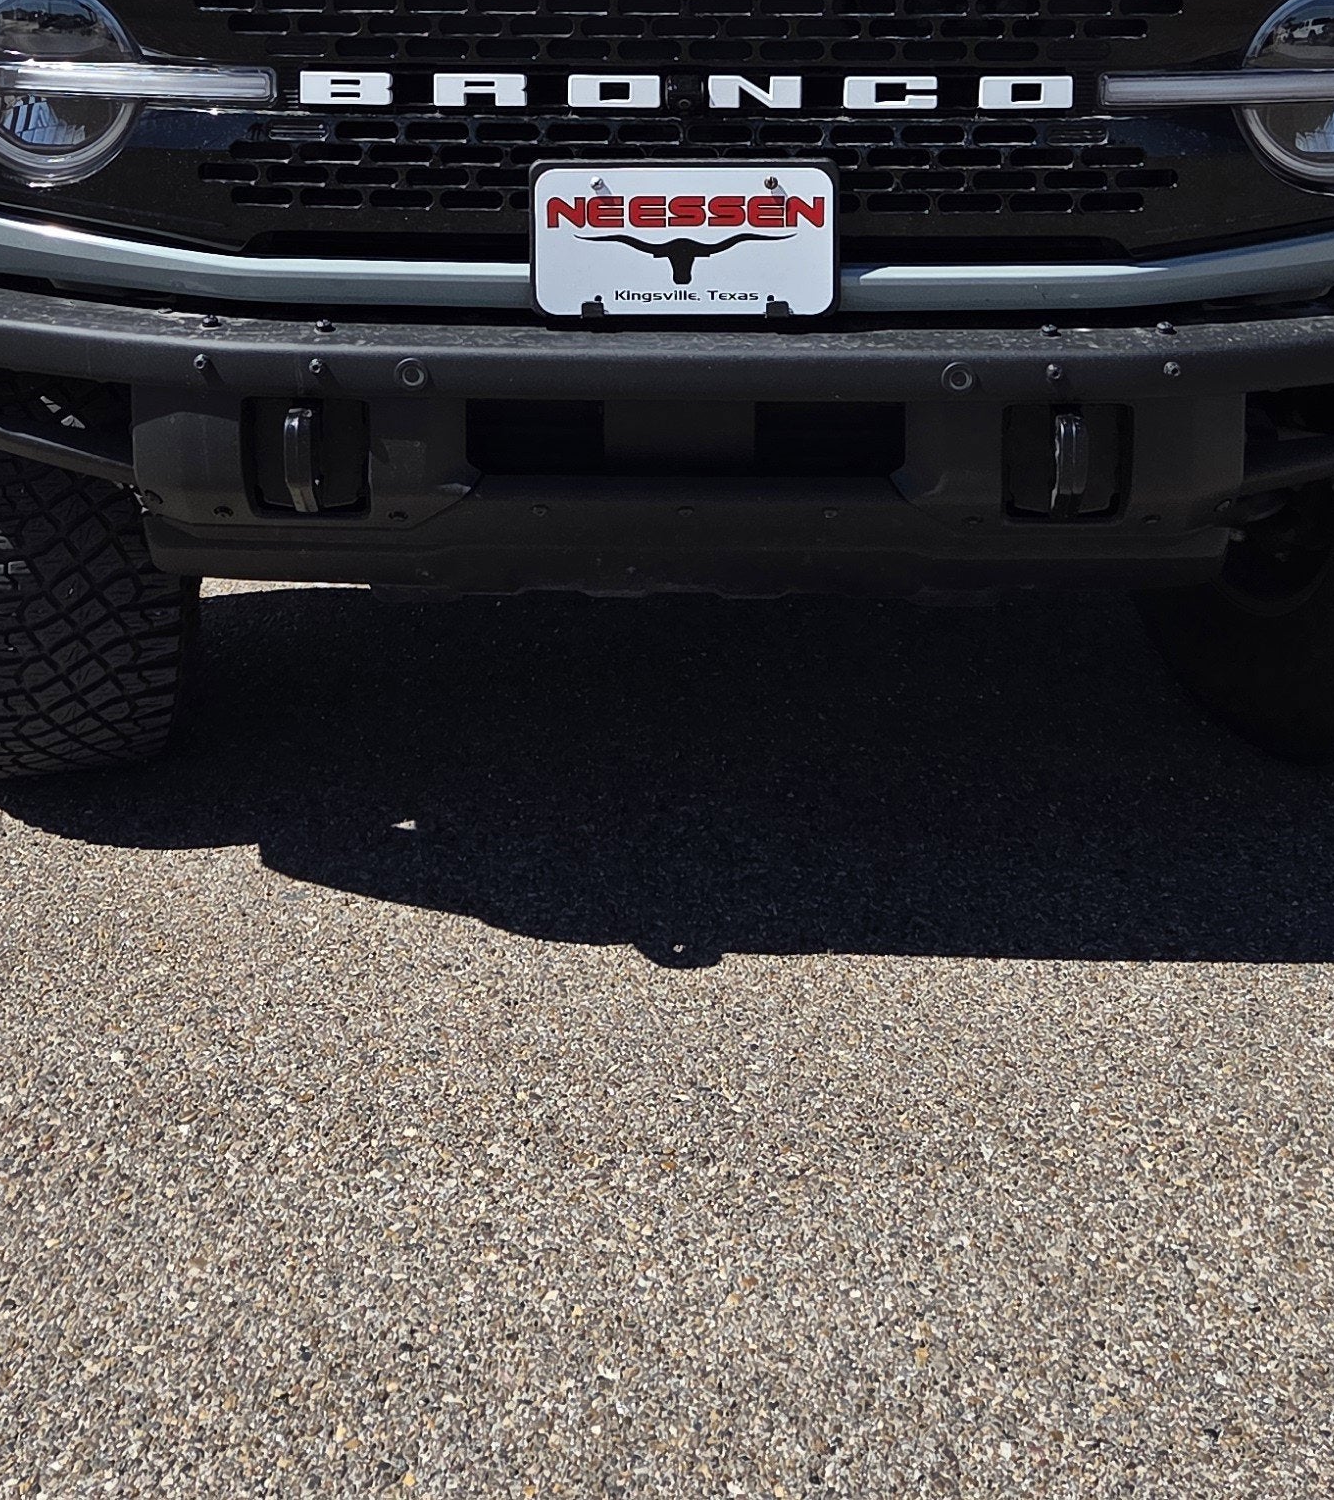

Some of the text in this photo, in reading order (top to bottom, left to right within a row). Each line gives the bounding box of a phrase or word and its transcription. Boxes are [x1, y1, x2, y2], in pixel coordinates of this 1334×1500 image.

[299, 71, 1073, 110] BRONCO
[546, 195, 825, 228] NEESSEN
[706, 289, 759, 301] Texas
